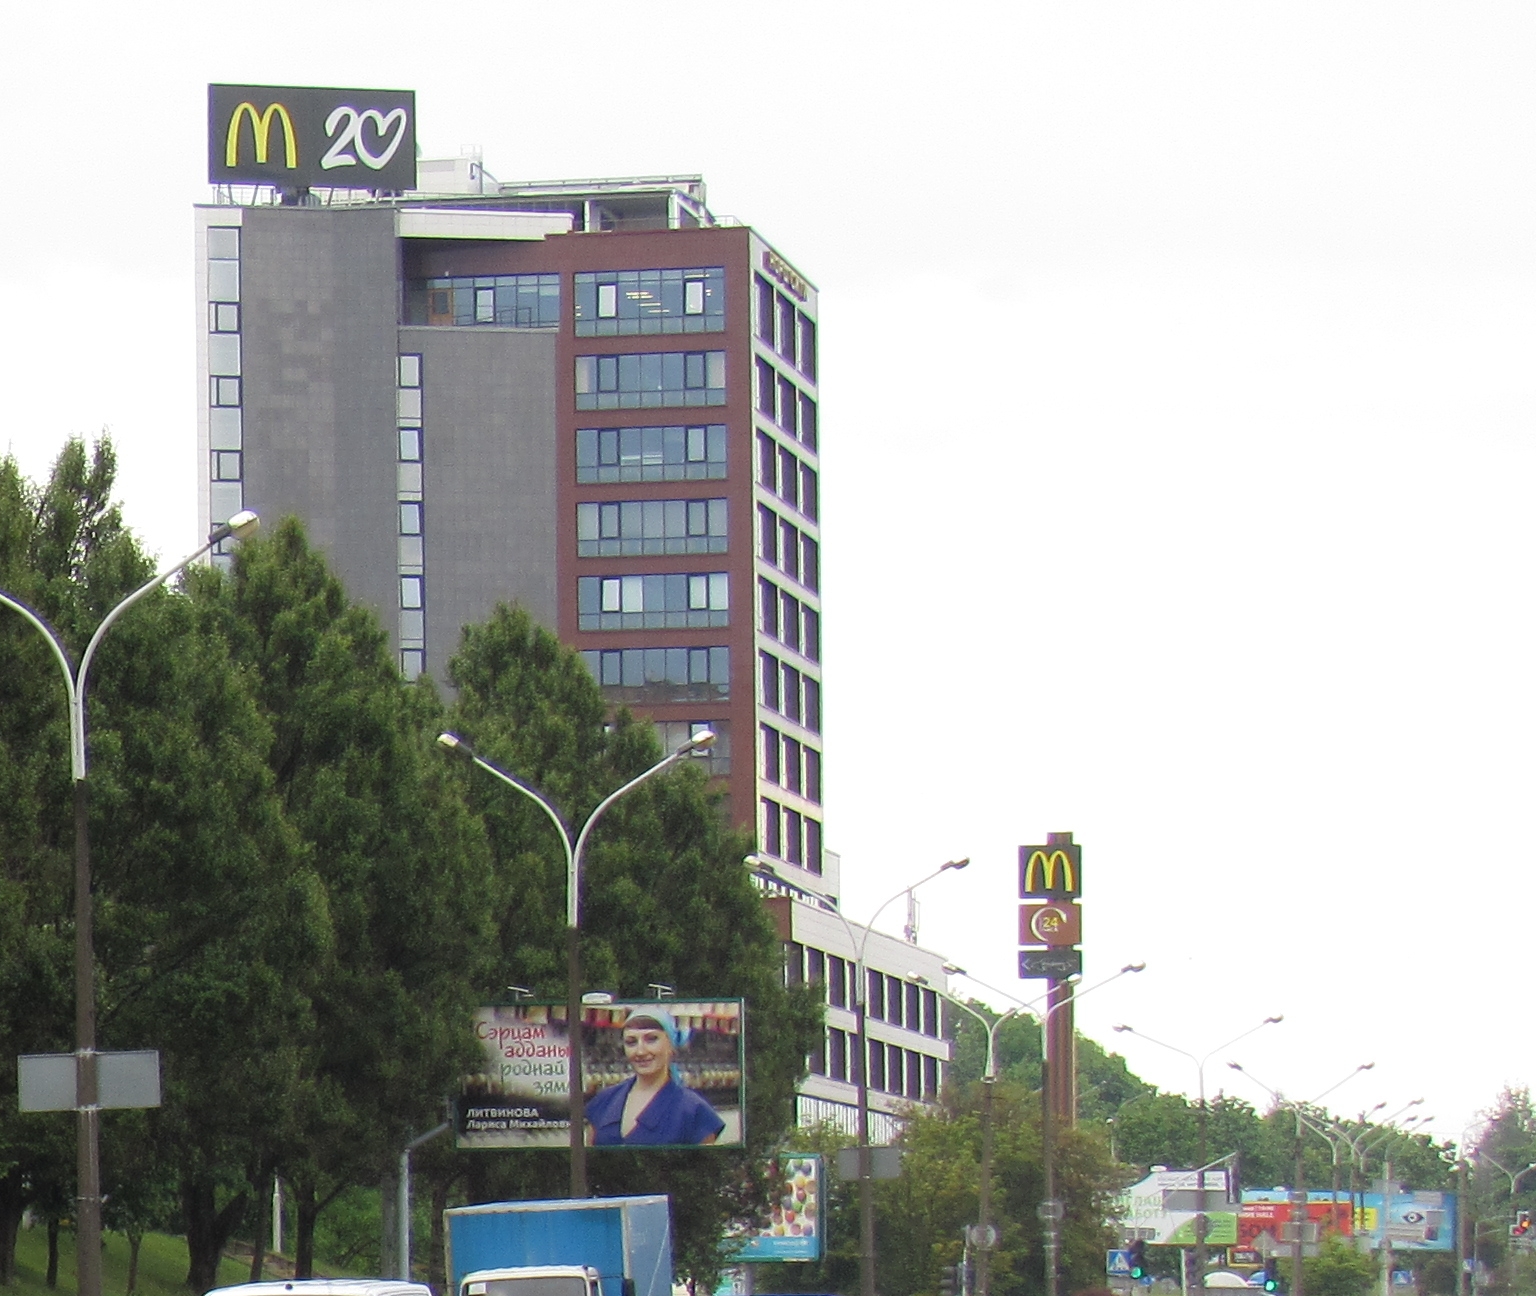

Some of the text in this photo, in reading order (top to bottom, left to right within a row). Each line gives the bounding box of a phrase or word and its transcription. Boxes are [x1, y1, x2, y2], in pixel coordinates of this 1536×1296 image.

[1042, 916, 1059, 927] 24
[504, 1041, 572, 1058] адданы
[500, 1060, 565, 1085] роднай
[533, 1081, 570, 1095] зям
[466, 1108, 540, 1118] ЛИТВИНОВА
[466, 1120, 507, 1130] Лариса
